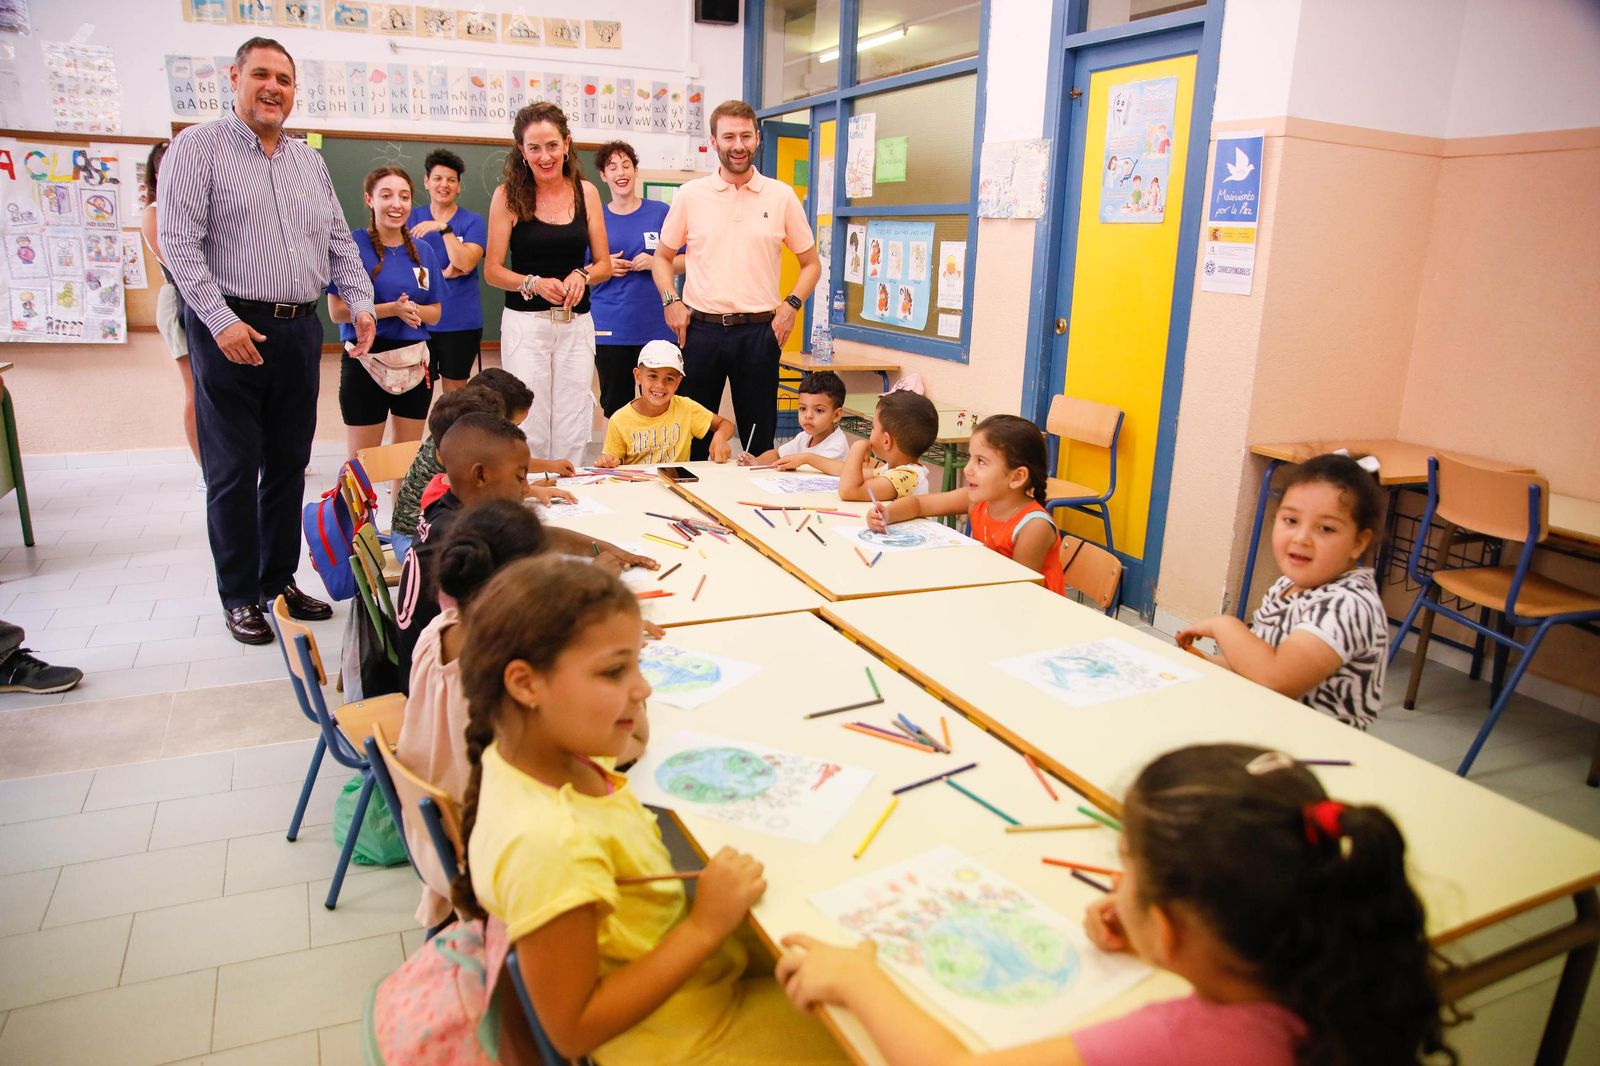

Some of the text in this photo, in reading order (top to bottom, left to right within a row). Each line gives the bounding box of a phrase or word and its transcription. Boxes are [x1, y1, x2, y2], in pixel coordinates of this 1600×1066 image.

[177, 98, 197, 110] aA
[200, 98, 219, 110] bB
[308, 100, 326, 113] gG
[329, 101, 347, 112] hH
[391, 103, 409, 114] kK
[430, 104, 449, 115] mM
[451, 105, 467, 116] nN
[470, 104, 487, 117] ñÑ
[489, 108, 506, 119] oO
[600, 114, 615, 124] uU
[617, 116, 633, 126] vV
[635, 117, 652, 127] wW
[653, 117, 667, 128] xX
[670, 119, 684, 130] yY
[1216, 189, 1255, 204] Movimiento
[1214, 201, 1253, 218] por la Paz
[632, 422, 681, 453] HELLO
